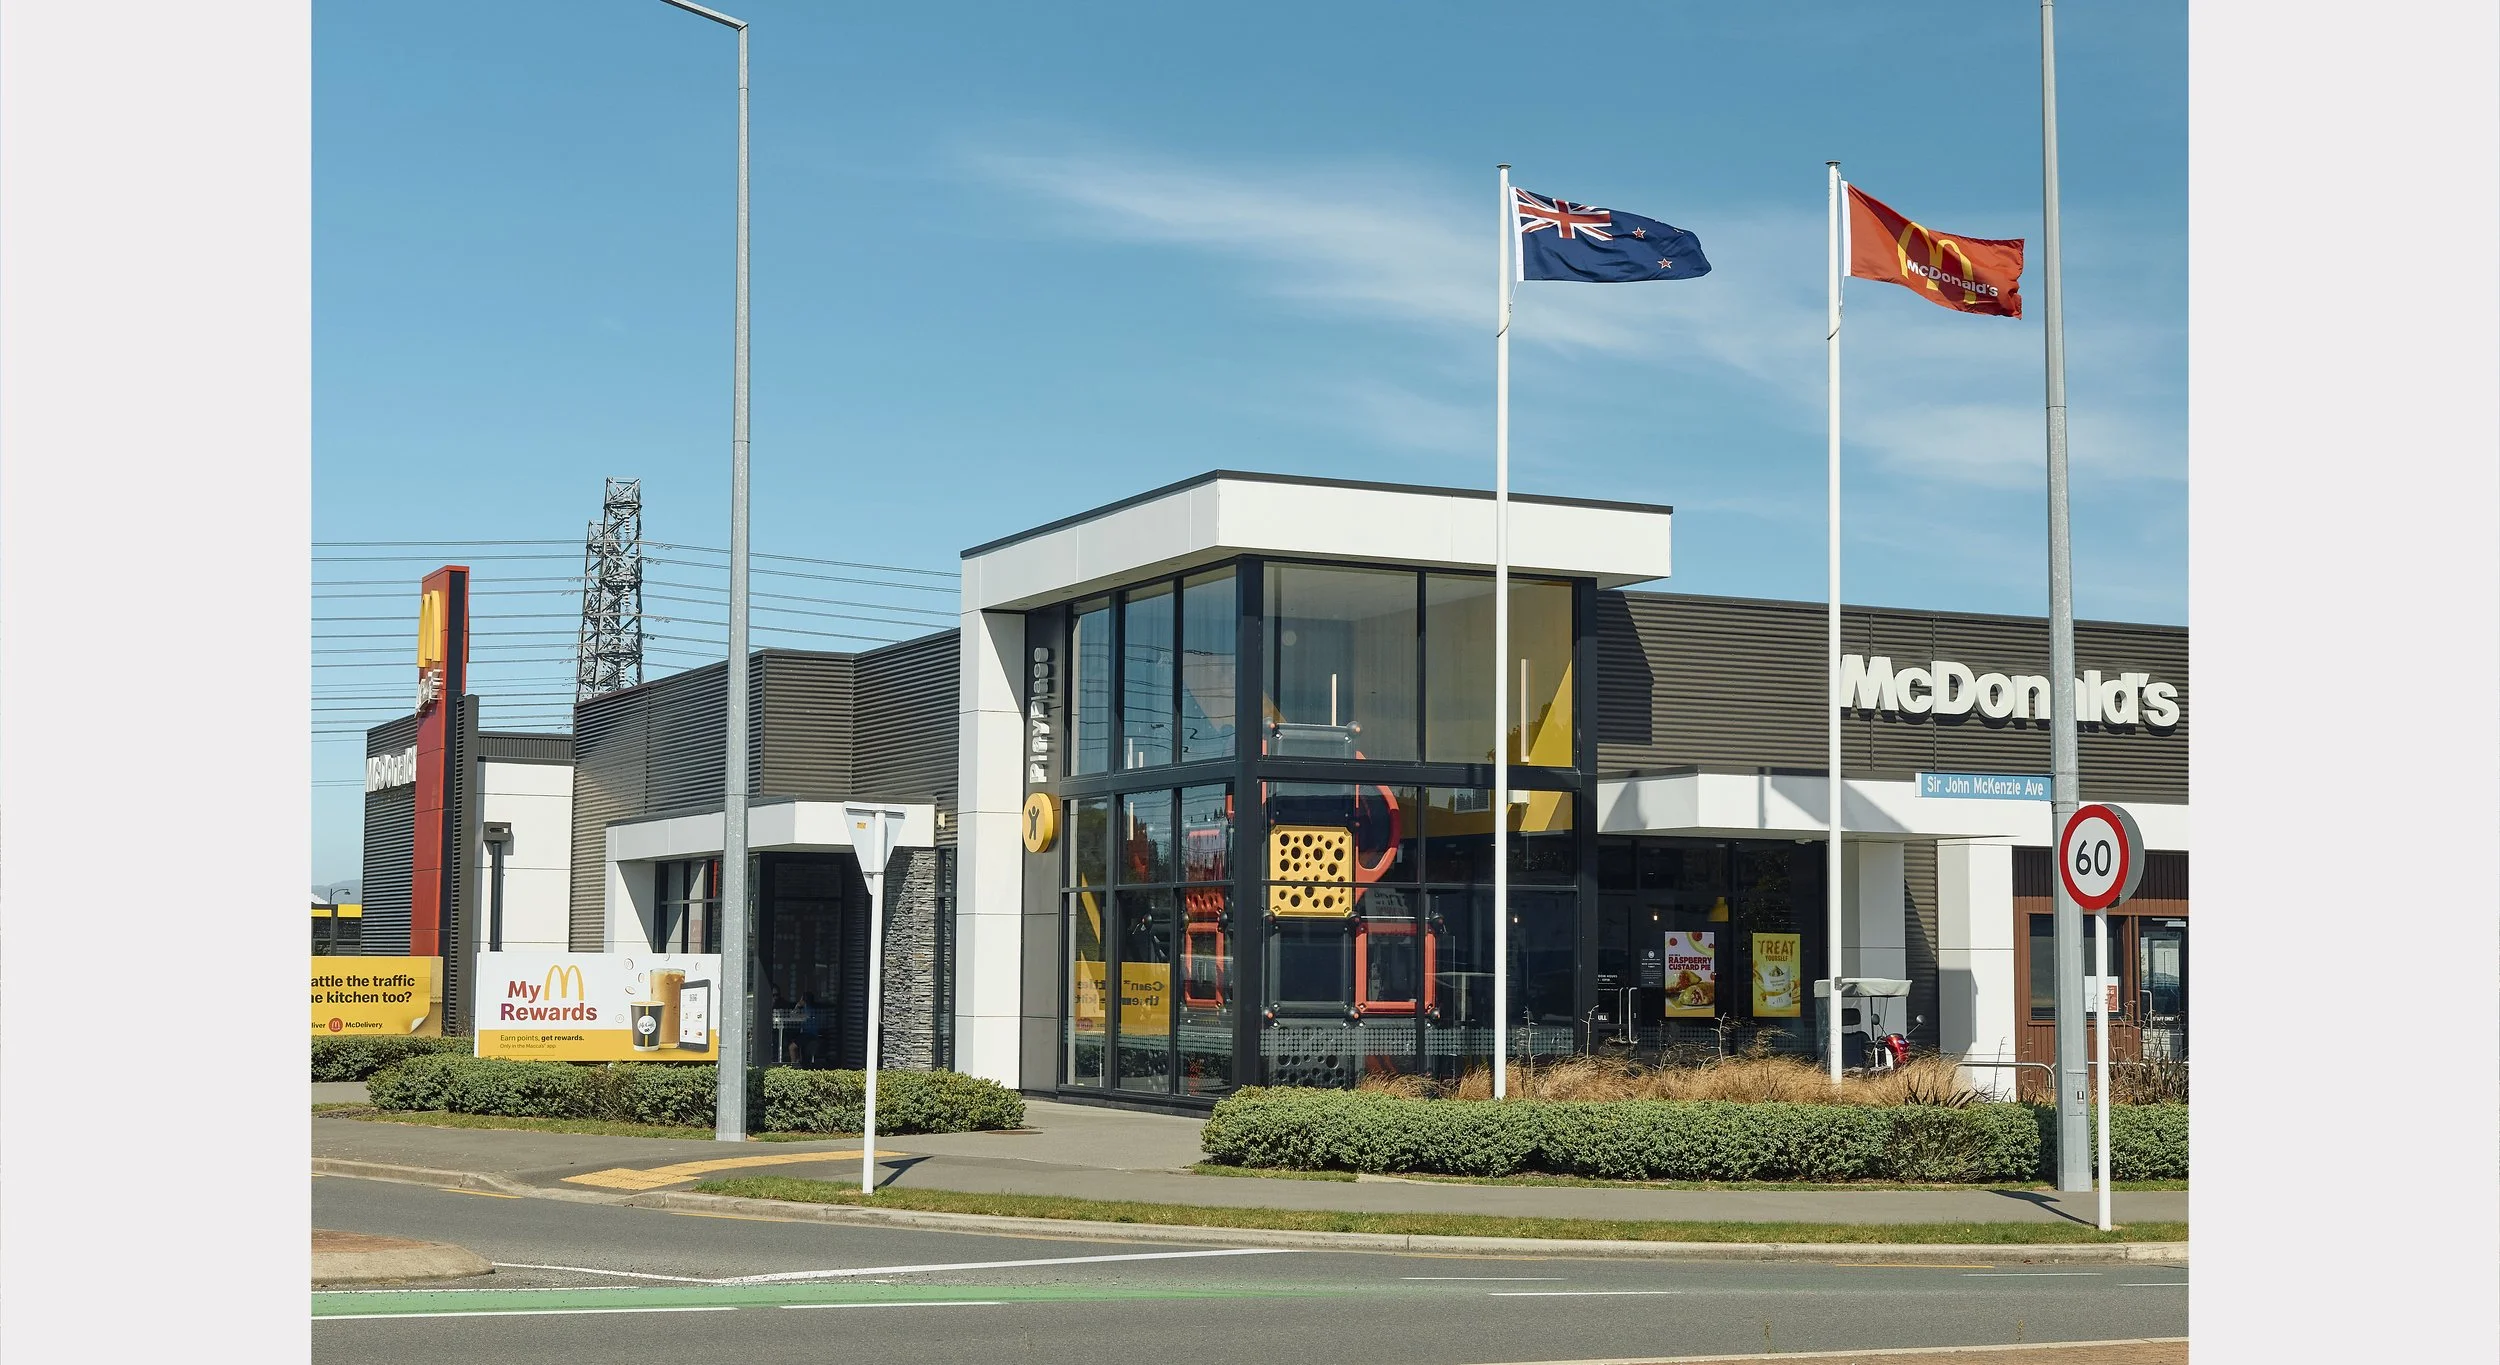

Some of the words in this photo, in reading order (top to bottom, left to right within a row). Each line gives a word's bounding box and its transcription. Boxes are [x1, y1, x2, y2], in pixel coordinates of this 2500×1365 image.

[1907, 260, 1999, 297] McDonald's
[1927, 776, 1942, 794] Sir
[1945, 777, 1970, 795] John
[1974, 777, 2021, 796] McKenzie
[2024, 778, 2044, 797] Ave
[2075, 839, 2112, 877] 60
[1757, 941, 1796, 957] TREAT
[1668, 963, 1700, 971] CUSTARD
[311, 975, 343, 987] attle
[346, 975, 369, 987] the
[372, 974, 415, 987] traffic
[326, 991, 379, 1003] kitchen
[382, 991, 412, 1003] too?
[507, 980, 542, 1004] My
[500, 1002, 598, 1021] Rewards
[345, 1021, 383, 1030] McDelivery
[541, 1035, 553, 1043] get
